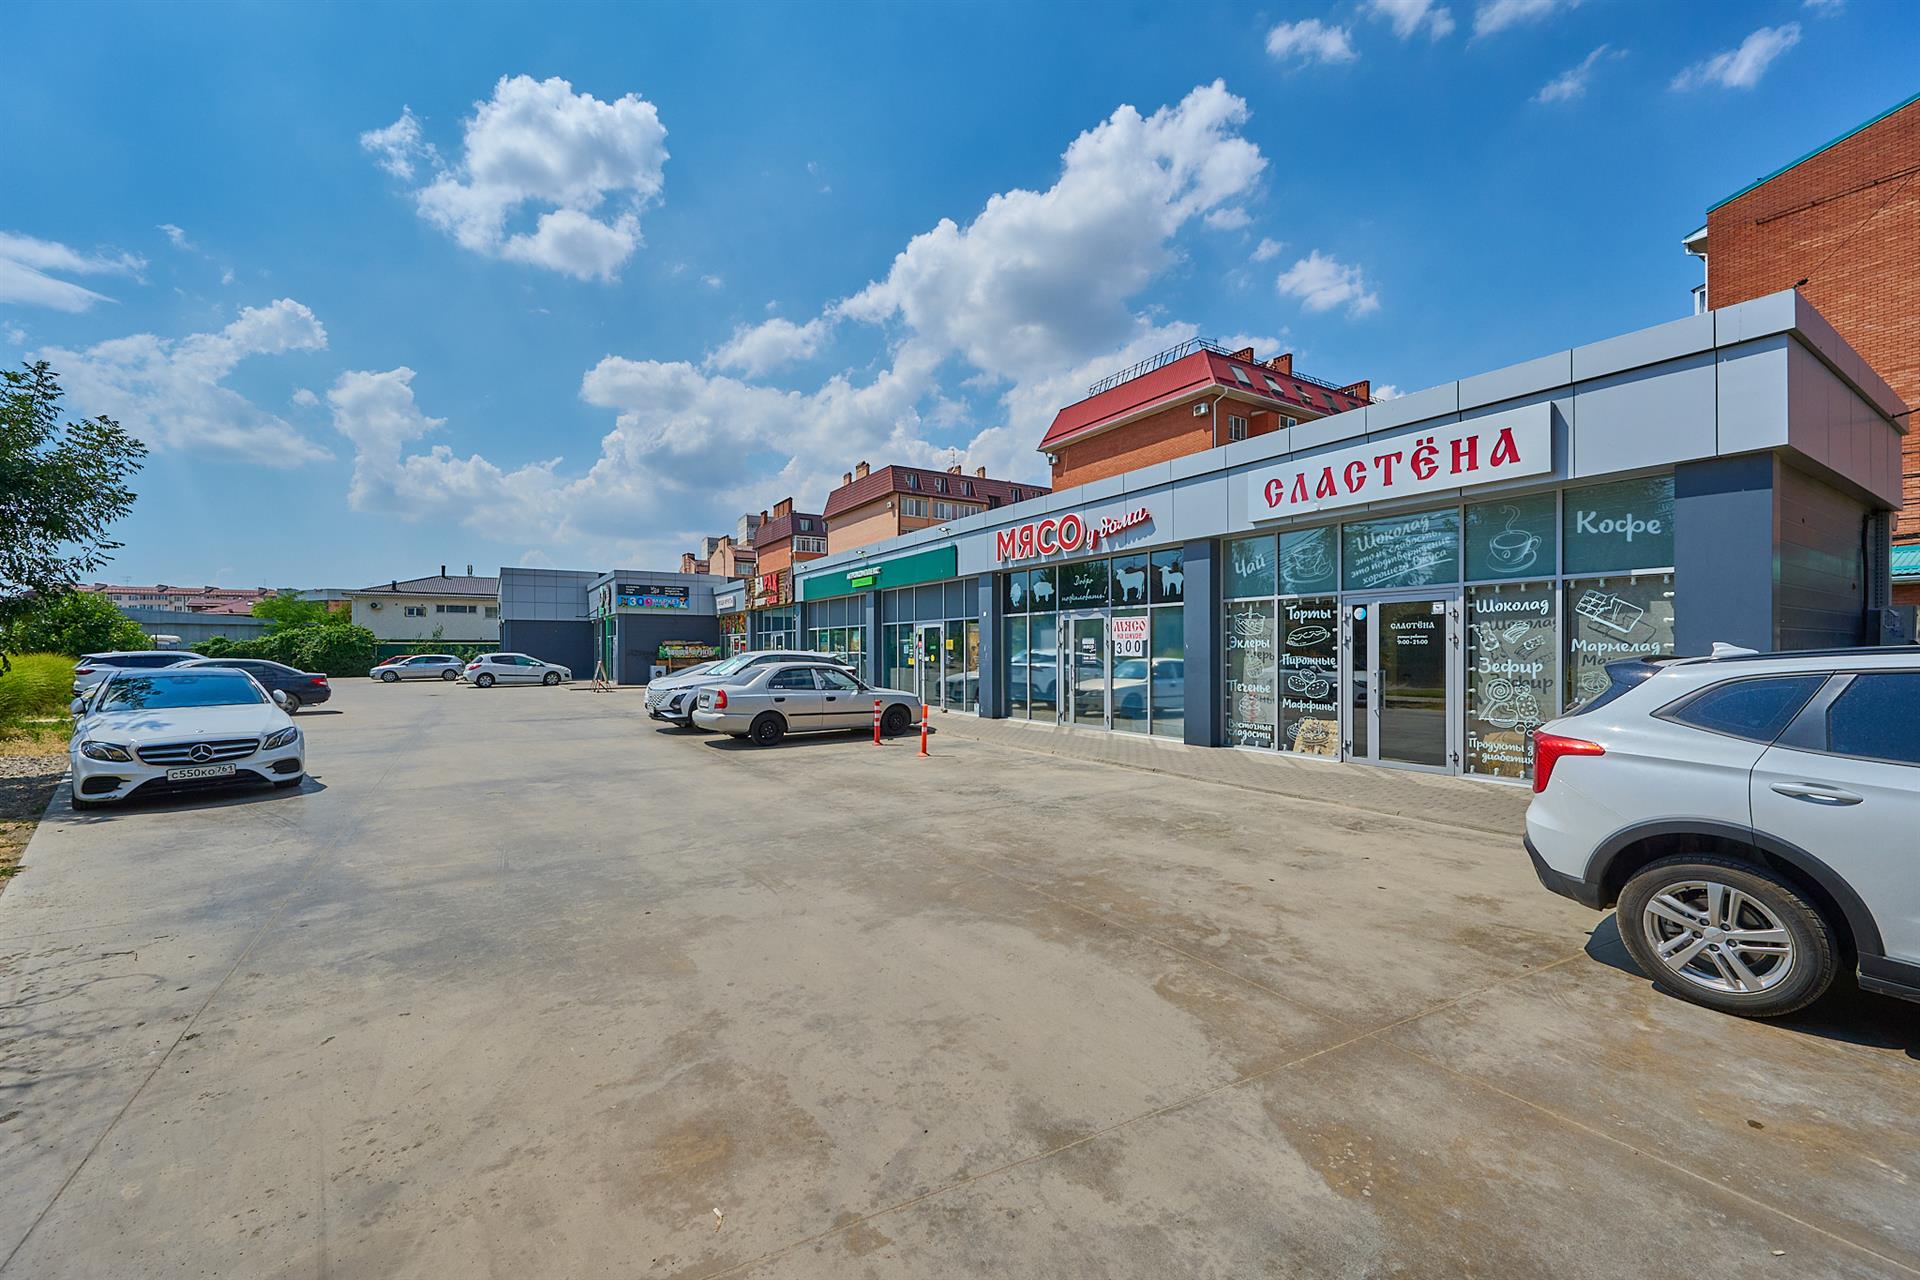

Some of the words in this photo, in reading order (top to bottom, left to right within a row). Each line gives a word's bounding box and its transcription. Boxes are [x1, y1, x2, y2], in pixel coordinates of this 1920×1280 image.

[1264, 427, 1521, 508] СЛАСТЁНА
[1357, 515, 1430, 552] Шоколад
[1576, 510, 1662, 542] Кофе
[996, 513, 1084, 562] МЯСО
[1235, 554, 1266, 578] Чай
[1285, 605, 1332, 624] Торты
[1476, 599, 1550, 615] Шоколад
[1114, 620, 1146, 632] МЯСО
[1116, 640, 1141, 654] 300
[1229, 636, 1270, 652] Эклеры
[1571, 638, 1661, 656] Мармелад
[1281, 653, 1337, 668] Пирожные
[1478, 657, 1544, 679] Зефир
[1229, 679, 1271, 693] Печенье
[1282, 698, 1338, 713] Маффины
[1468, 738, 1525, 752] Продукты
[1482, 751, 1534, 765] диабетик
